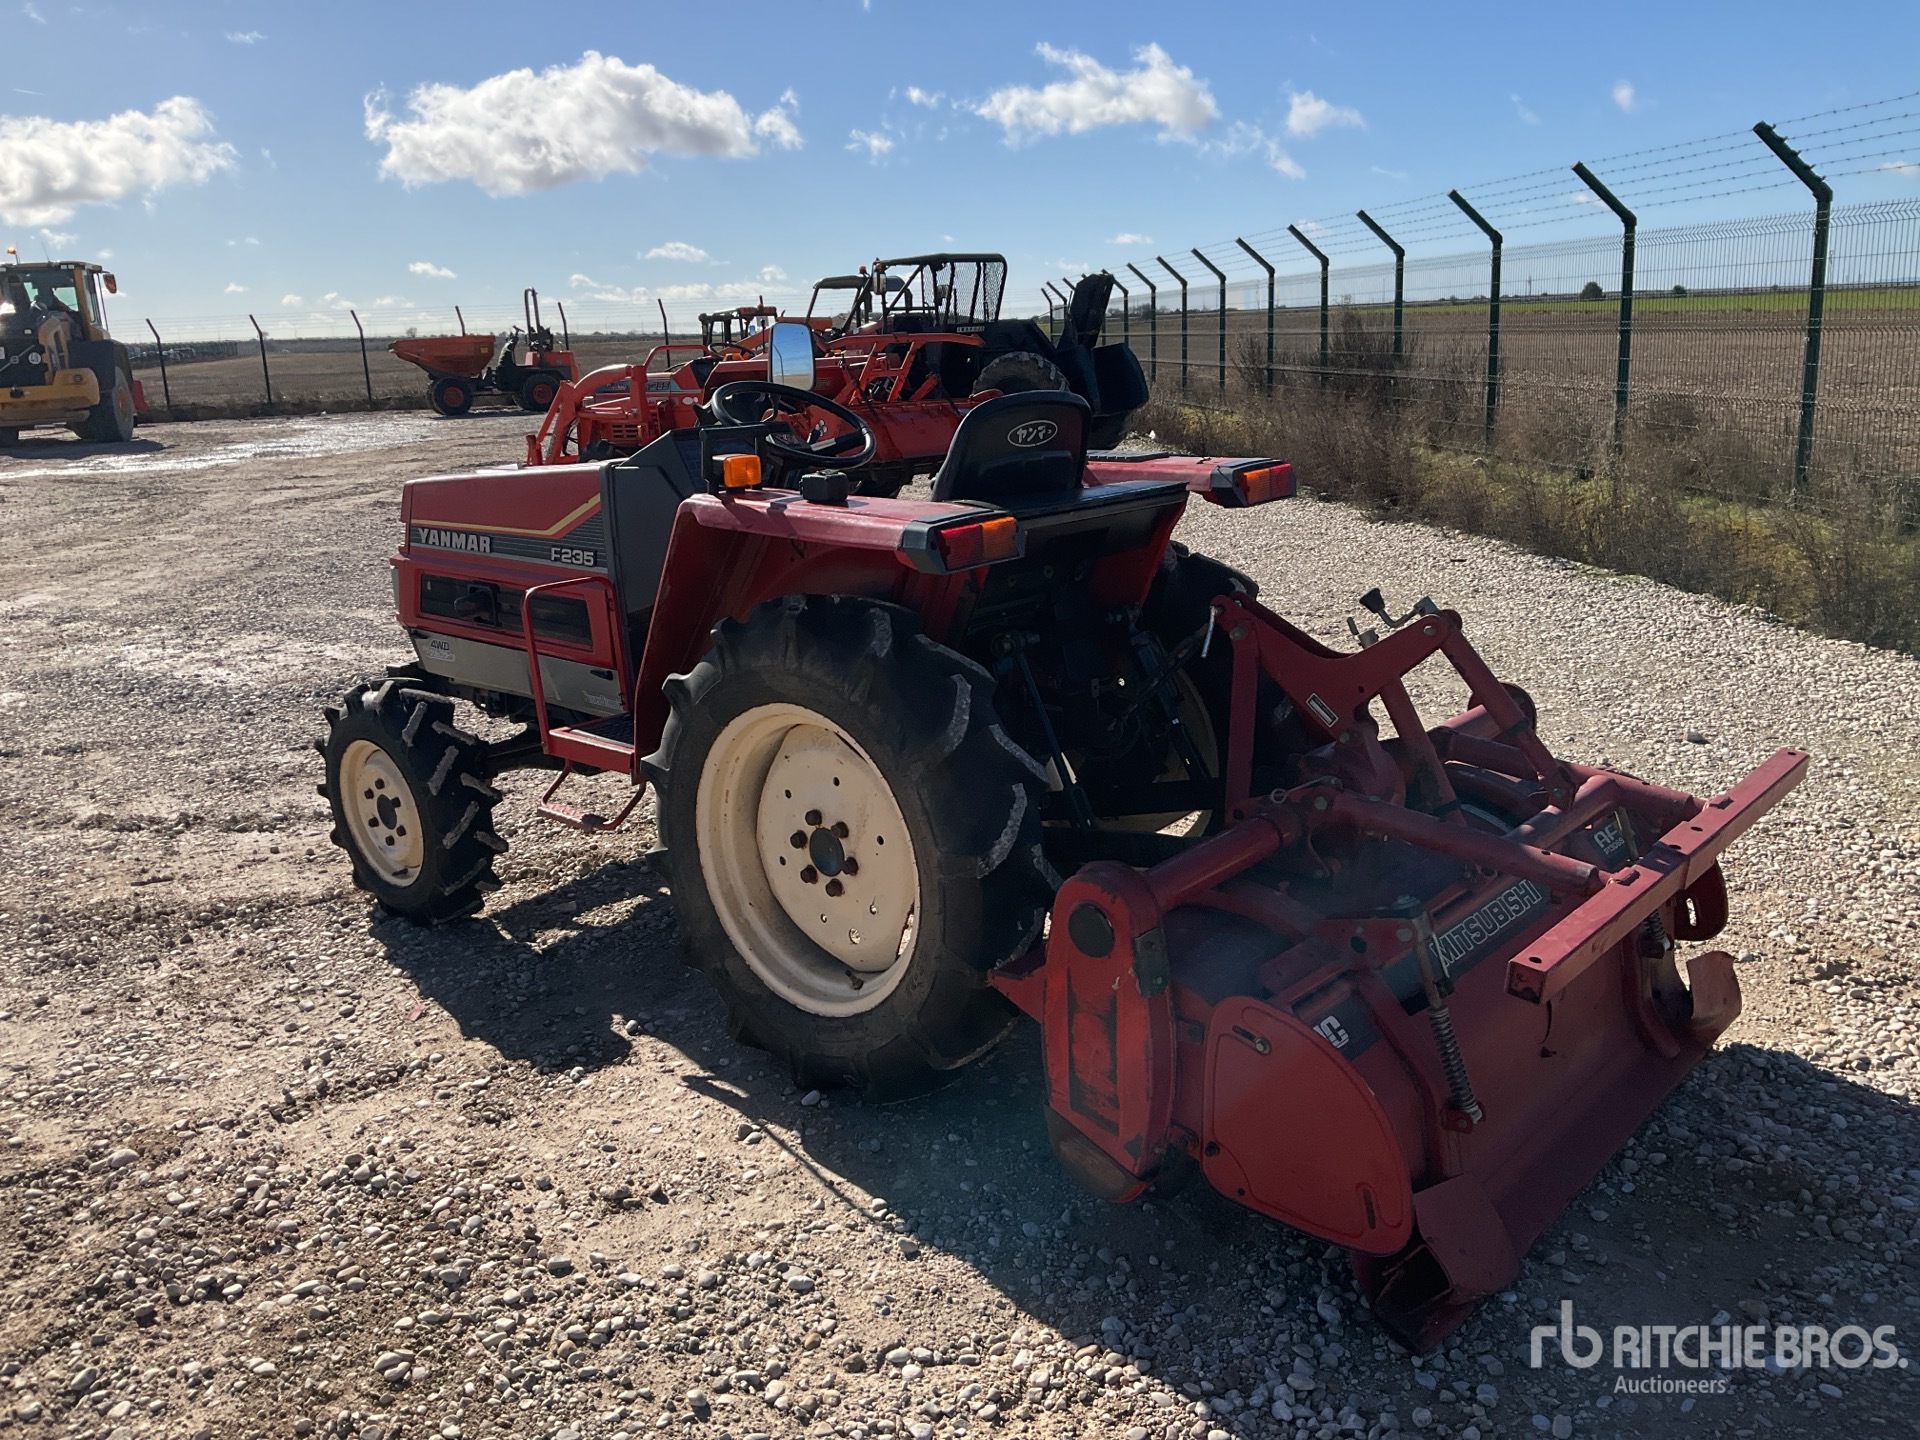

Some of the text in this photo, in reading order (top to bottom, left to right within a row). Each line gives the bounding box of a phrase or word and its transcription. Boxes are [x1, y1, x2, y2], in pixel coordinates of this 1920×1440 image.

[418, 528, 491, 553] YANMAR
[551, 547, 594, 566] F235
[430, 639, 450, 651] 4WD
[1593, 823, 1618, 849] AF
[1428, 879, 1543, 968] MITSUBISHI
